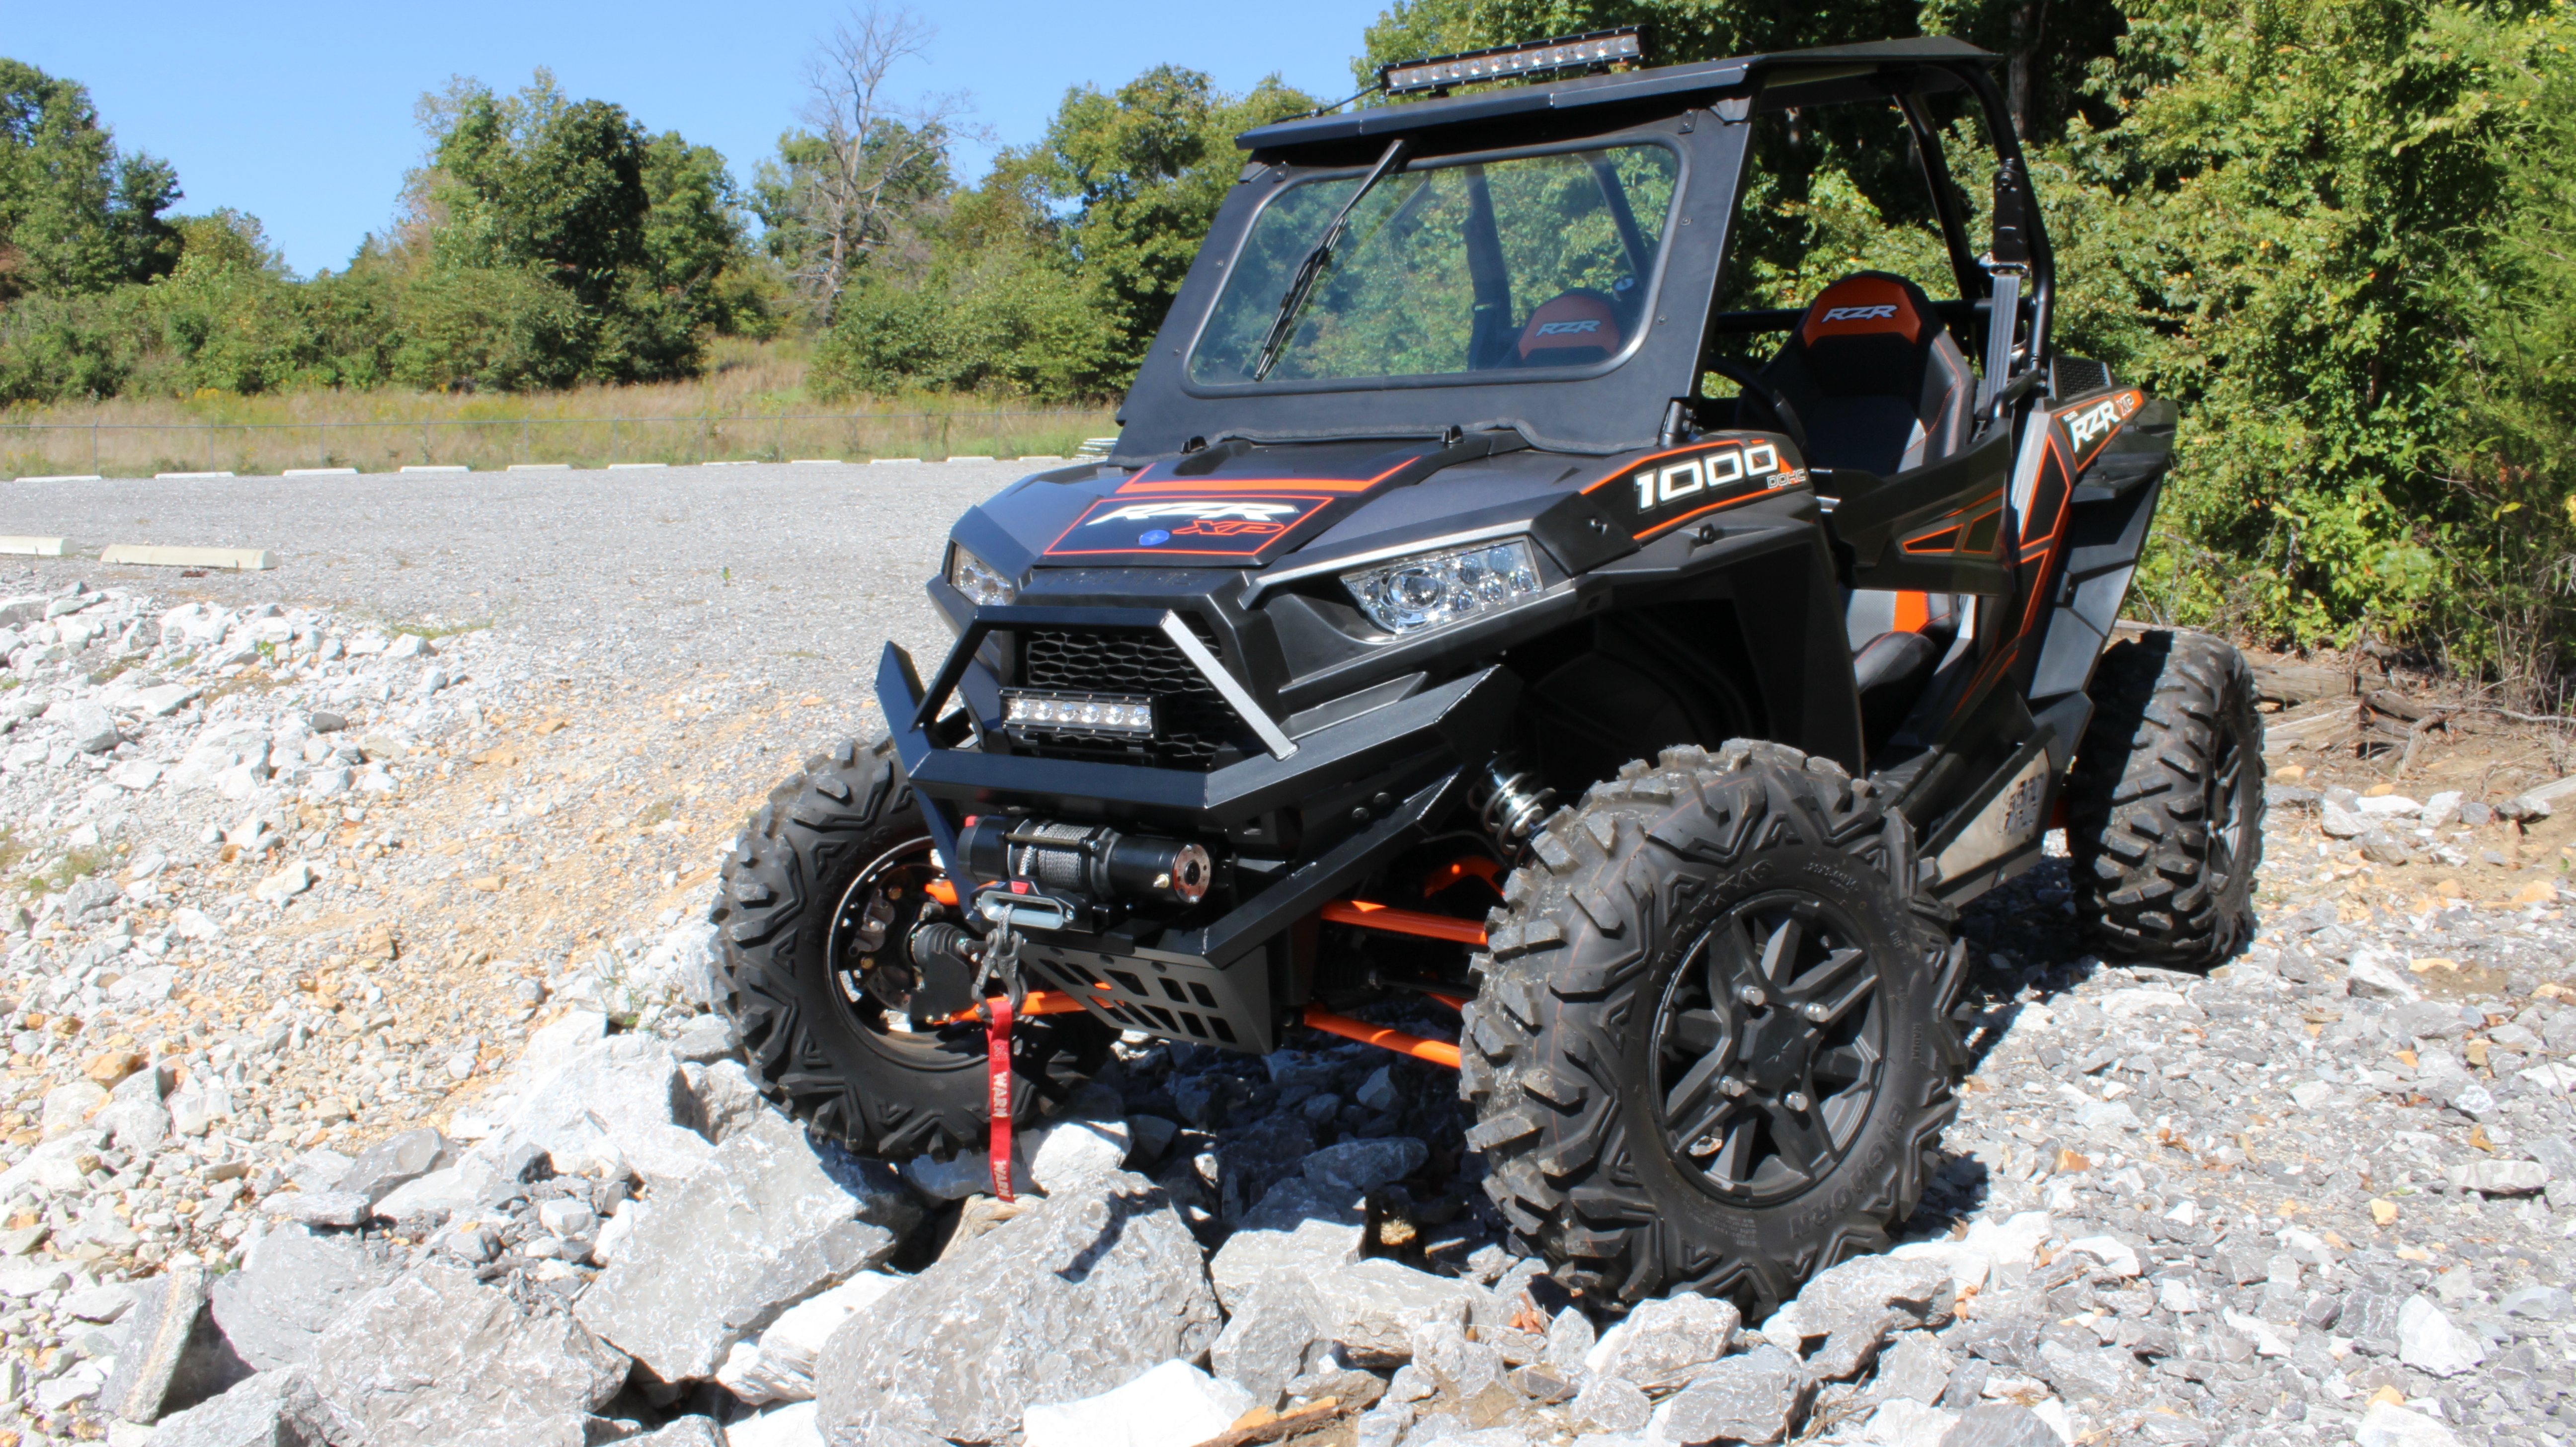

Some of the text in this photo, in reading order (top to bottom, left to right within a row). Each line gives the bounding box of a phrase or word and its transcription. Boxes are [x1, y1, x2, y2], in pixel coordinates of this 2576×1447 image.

[1822, 304, 1899, 323] RZR
[1535, 319, 1603, 338] RZR
[2069, 393, 2135, 453] RZR XP
[1634, 443, 1779, 512] 1000
[1766, 468, 1807, 489] DOHC
[1085, 501, 1298, 526] RZR
[1172, 520, 1286, 536] XP
[992, 1071, 1010, 1118] WARN
[994, 1160, 1011, 1198] WARN
